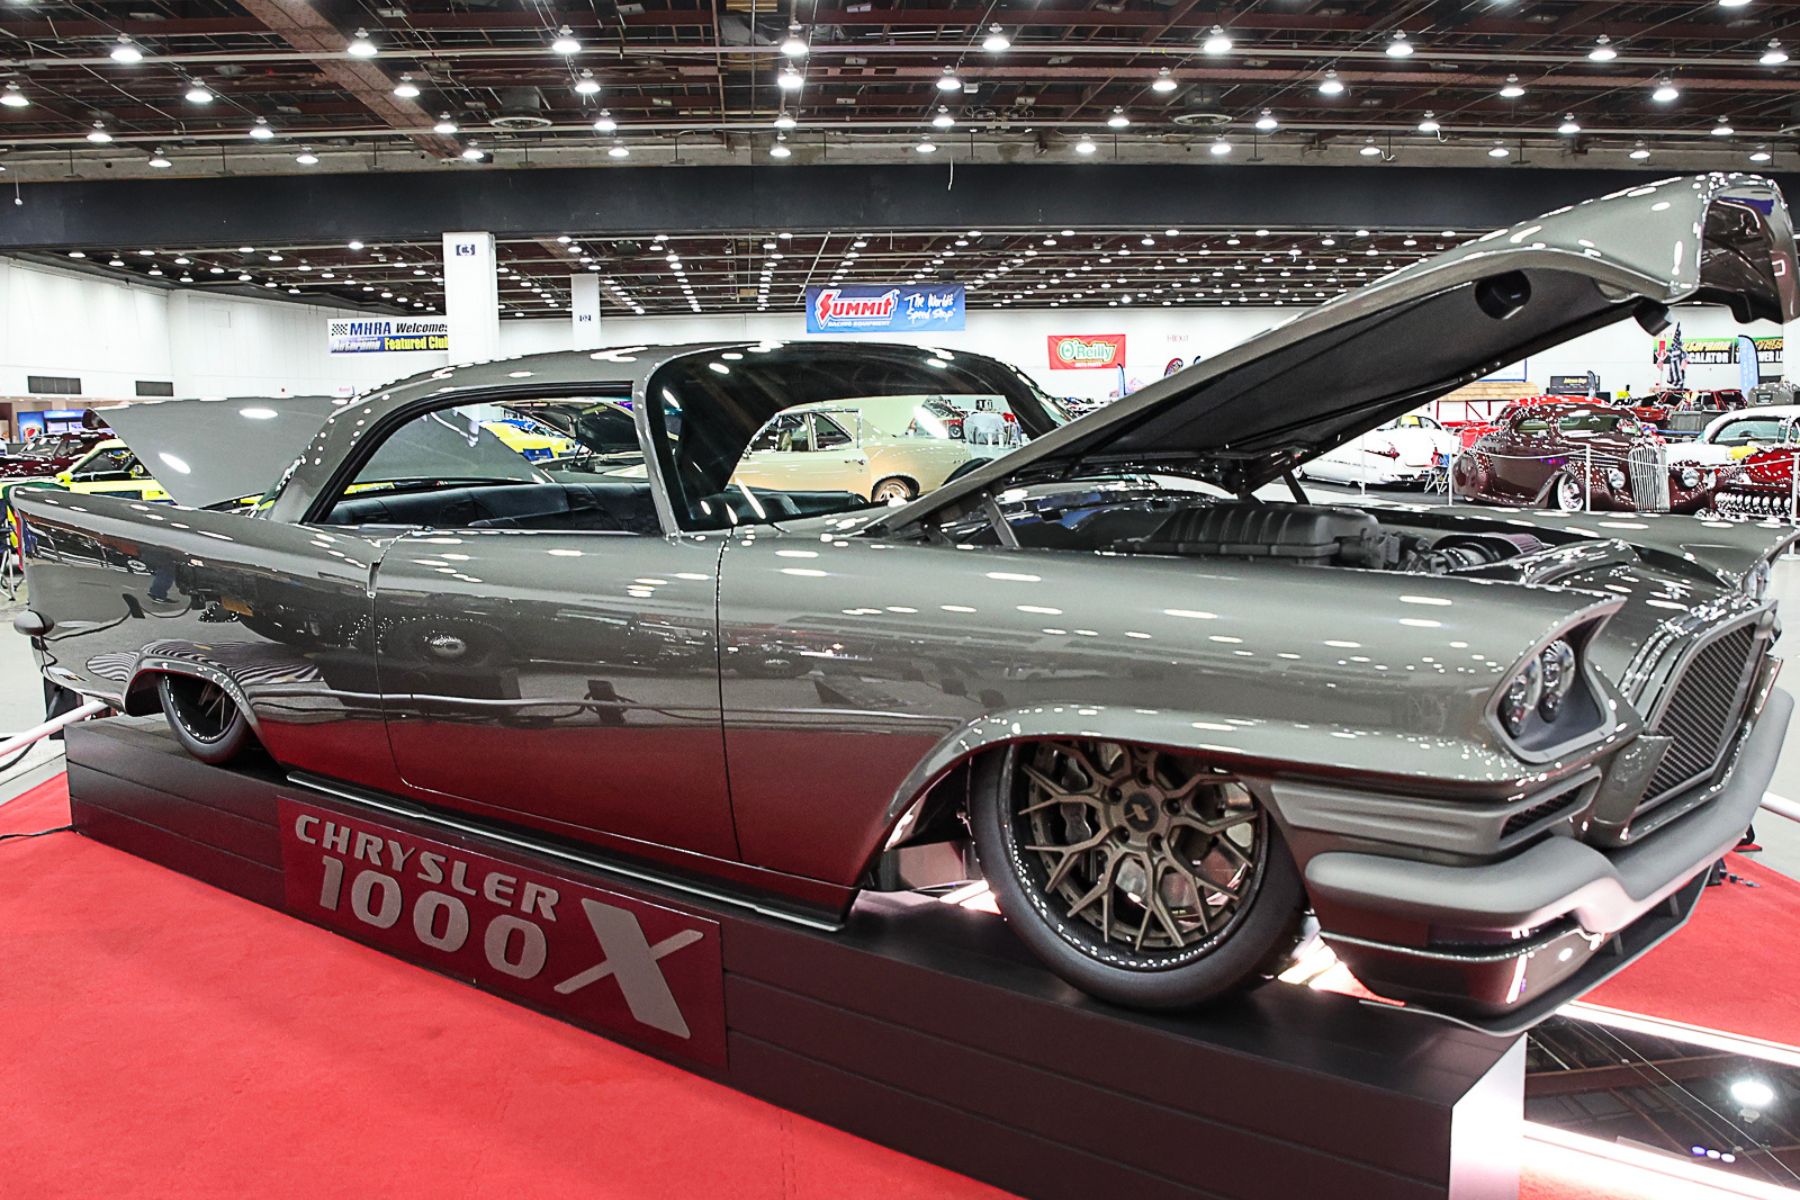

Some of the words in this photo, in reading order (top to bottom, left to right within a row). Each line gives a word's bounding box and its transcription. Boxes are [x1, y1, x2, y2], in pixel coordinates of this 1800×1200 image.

[904, 293, 926, 309] The
[350, 321, 391, 336] MHRA
[384, 337, 427, 350] Featured
[1686, 351, 1730, 363] CALATOR
[295, 814, 559, 923] CHRYSLER
